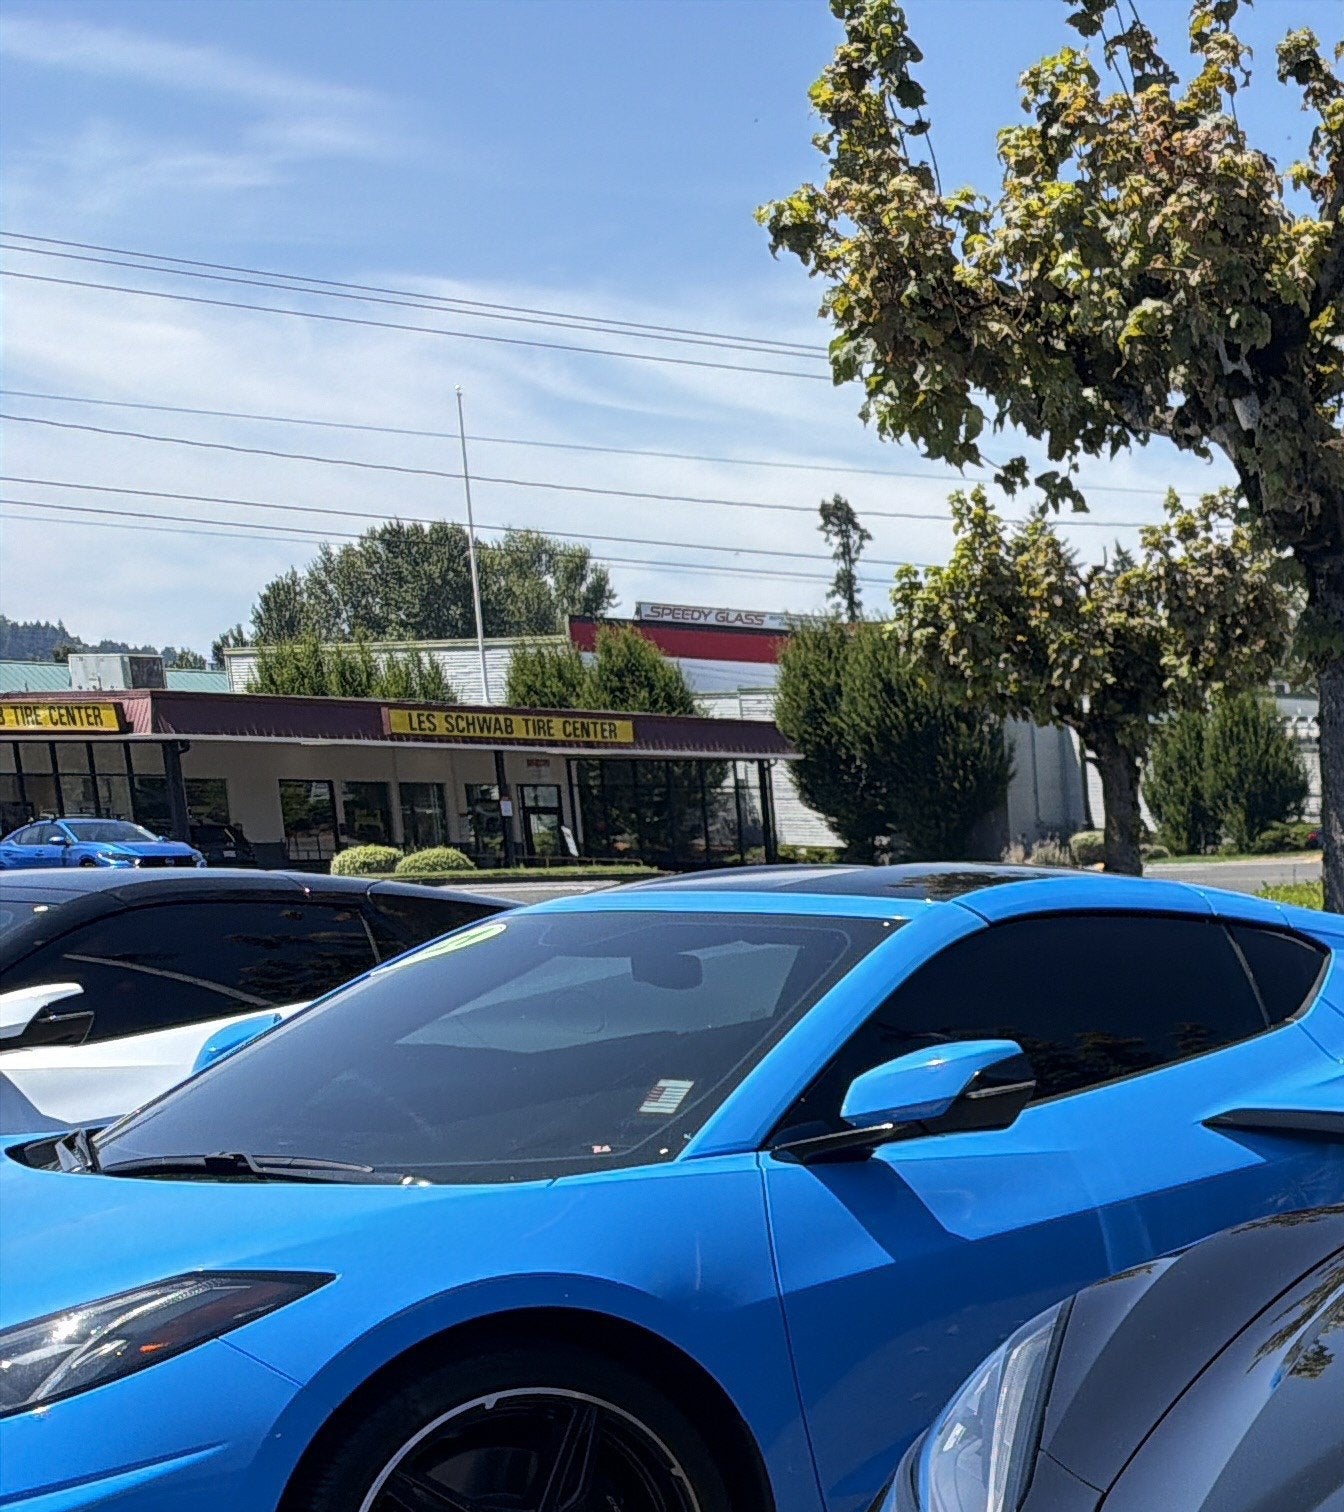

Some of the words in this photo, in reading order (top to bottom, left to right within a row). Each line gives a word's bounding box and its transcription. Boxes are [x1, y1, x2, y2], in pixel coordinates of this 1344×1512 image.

[645, 606, 712, 622] SPEEDY
[715, 611, 766, 626] GLASS
[11, 705, 43, 726] TIRE
[48, 705, 103, 726] CENTER
[407, 712, 437, 732] LES
[444, 714, 514, 735] SCHWAB
[522, 718, 555, 737] TIRE
[562, 719, 618, 740] CENTER
